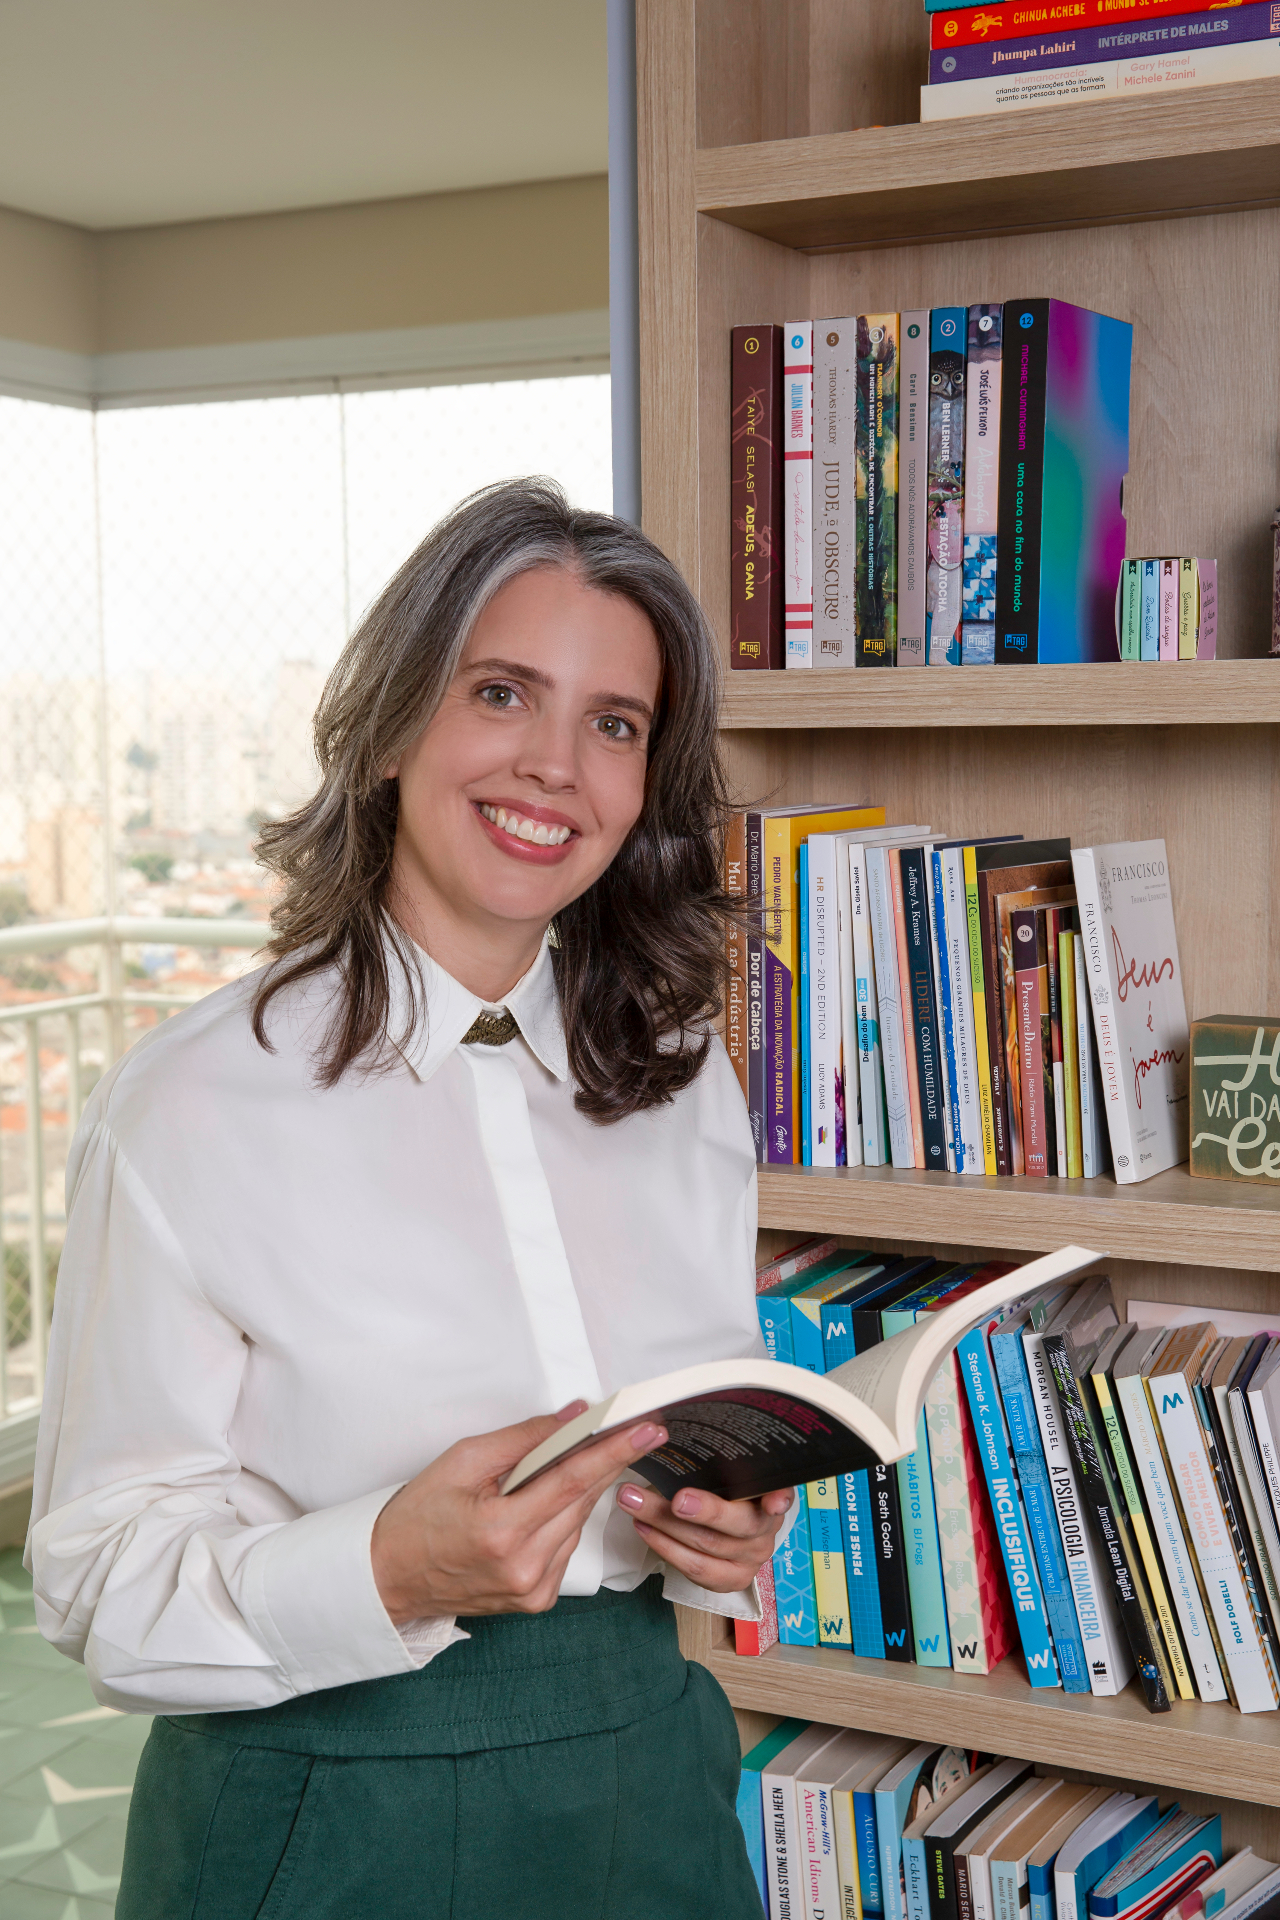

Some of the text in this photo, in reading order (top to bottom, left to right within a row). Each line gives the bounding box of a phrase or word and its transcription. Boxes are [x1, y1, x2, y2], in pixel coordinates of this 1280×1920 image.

[1014, 3, 1085, 24] CHINUA ACHEBE
[992, 20, 1228, 64] Jhumpa Lahiri INTÉRPRETE DE MALES
[1130, 56, 1190, 72] Gary Hamel
[996, 82, 1064, 96] criando organizações
[996, 82, 1105, 104] quanto pessoas formam
[1014, 69, 1088, 86] Humanocracia:
[1124, 68, 1196, 86] Michele Zanini
[979, 390, 992, 406] LUÍS
[980, 369, 992, 389] JOSÉ
[791, 384, 803, 438] JULIAN BARNES
[978, 406, 988, 436] PEIXOTO
[908, 374, 918, 556] Carol Bensimon TODOS NÓS ADORÁVAMOS
[744, 396, 756, 600] TAIYE SELASI ADEUS, GANA
[824, 367, 840, 620] THOMAS HARDY OBSCURO
[936, 402, 951, 614] BEN LERNER ESTAÇÃO ATOCHA
[1013, 463, 1025, 612] uma casa no fim do mundo
[816, 876, 824, 892] HR
[1112, 861, 1165, 882] FRANCISCO
[966, 892, 976, 904] 12
[748, 832, 762, 1050] Dr. Mario Dor de Cabeça
[816, 896, 825, 956] DISRUPTED
[817, 968, 826, 991] 2ND
[1111, 924, 1174, 1002] Deus
[774, 973, 784, 1017] ESTRATÉGIA
[908, 866, 937, 1120] Jeffrey Krames LIDERE COM HUMILDADE
[1085, 902, 1118, 1101] FRANCISCO DEUS JOVEM
[774, 1020, 782, 1030] DA
[818, 995, 826, 1040] EDITION
[772, 1032, 785, 1070] INOVAÇÃO
[775, 1072, 784, 1116] RADICAL
[1128, 1047, 1184, 1110] jovem
[1203, 1088, 1232, 1120] VAI
[1032, 1352, 1049, 1400] MORGAN
[1008, 1398, 1026, 1447] AMYR KLINK
[1044, 1405, 1058, 1450] HOUSEL
[1105, 1416, 1116, 1428] 12
[1130, 1392, 1144, 1422] MENDES
[940, 1418, 954, 1464] PONTO
[967, 1352, 1036, 1612] Stefanie K. Johnson INCLUSIFIQUE
[1052, 1466, 1068, 1476] A
[1188, 1450, 1209, 1500] MELHOR
[844, 1472, 863, 1576] PENSE DE NOVO
[878, 1491, 893, 1559] Seth Godin
[1054, 1478, 1084, 1558] PSICOLOGIA
[1180, 1462, 1210, 1548] COMO PENSAR
[1202, 1501, 1220, 1538] VIVER
[784, 1550, 794, 1576] Syed
[818, 1510, 832, 1570] Liz Wiseman
[914, 1528, 924, 1566] BJ Fogg
[1036, 1530, 1056, 1588] CEM DIAS ENTRE
[1096, 1505, 1135, 1602] Jornada Lean Digital
[1149, 1461, 1200, 1637] Como se dar bem com quem você quer bem
[1254, 1530, 1277, 1601] SORRINDO PRA VIDA
[1070, 1560, 1101, 1641] FINANCEIRA
[1218, 1580, 1244, 1644] ROLF DOBELLI
[772, 1788, 788, 1884] STONE SHEILA HEEN
[804, 1788, 817, 1853] American
[819, 1789, 830, 1856] McGraw-Hill's
[809, 1859, 822, 1903] Idioms
[864, 1814, 879, 1906] AUGUSTO CURY
[909, 1854, 921, 1900] Eckhart
[936, 1850, 946, 1899] STEVE GATES
[958, 1868, 968, 1898] MARIO
